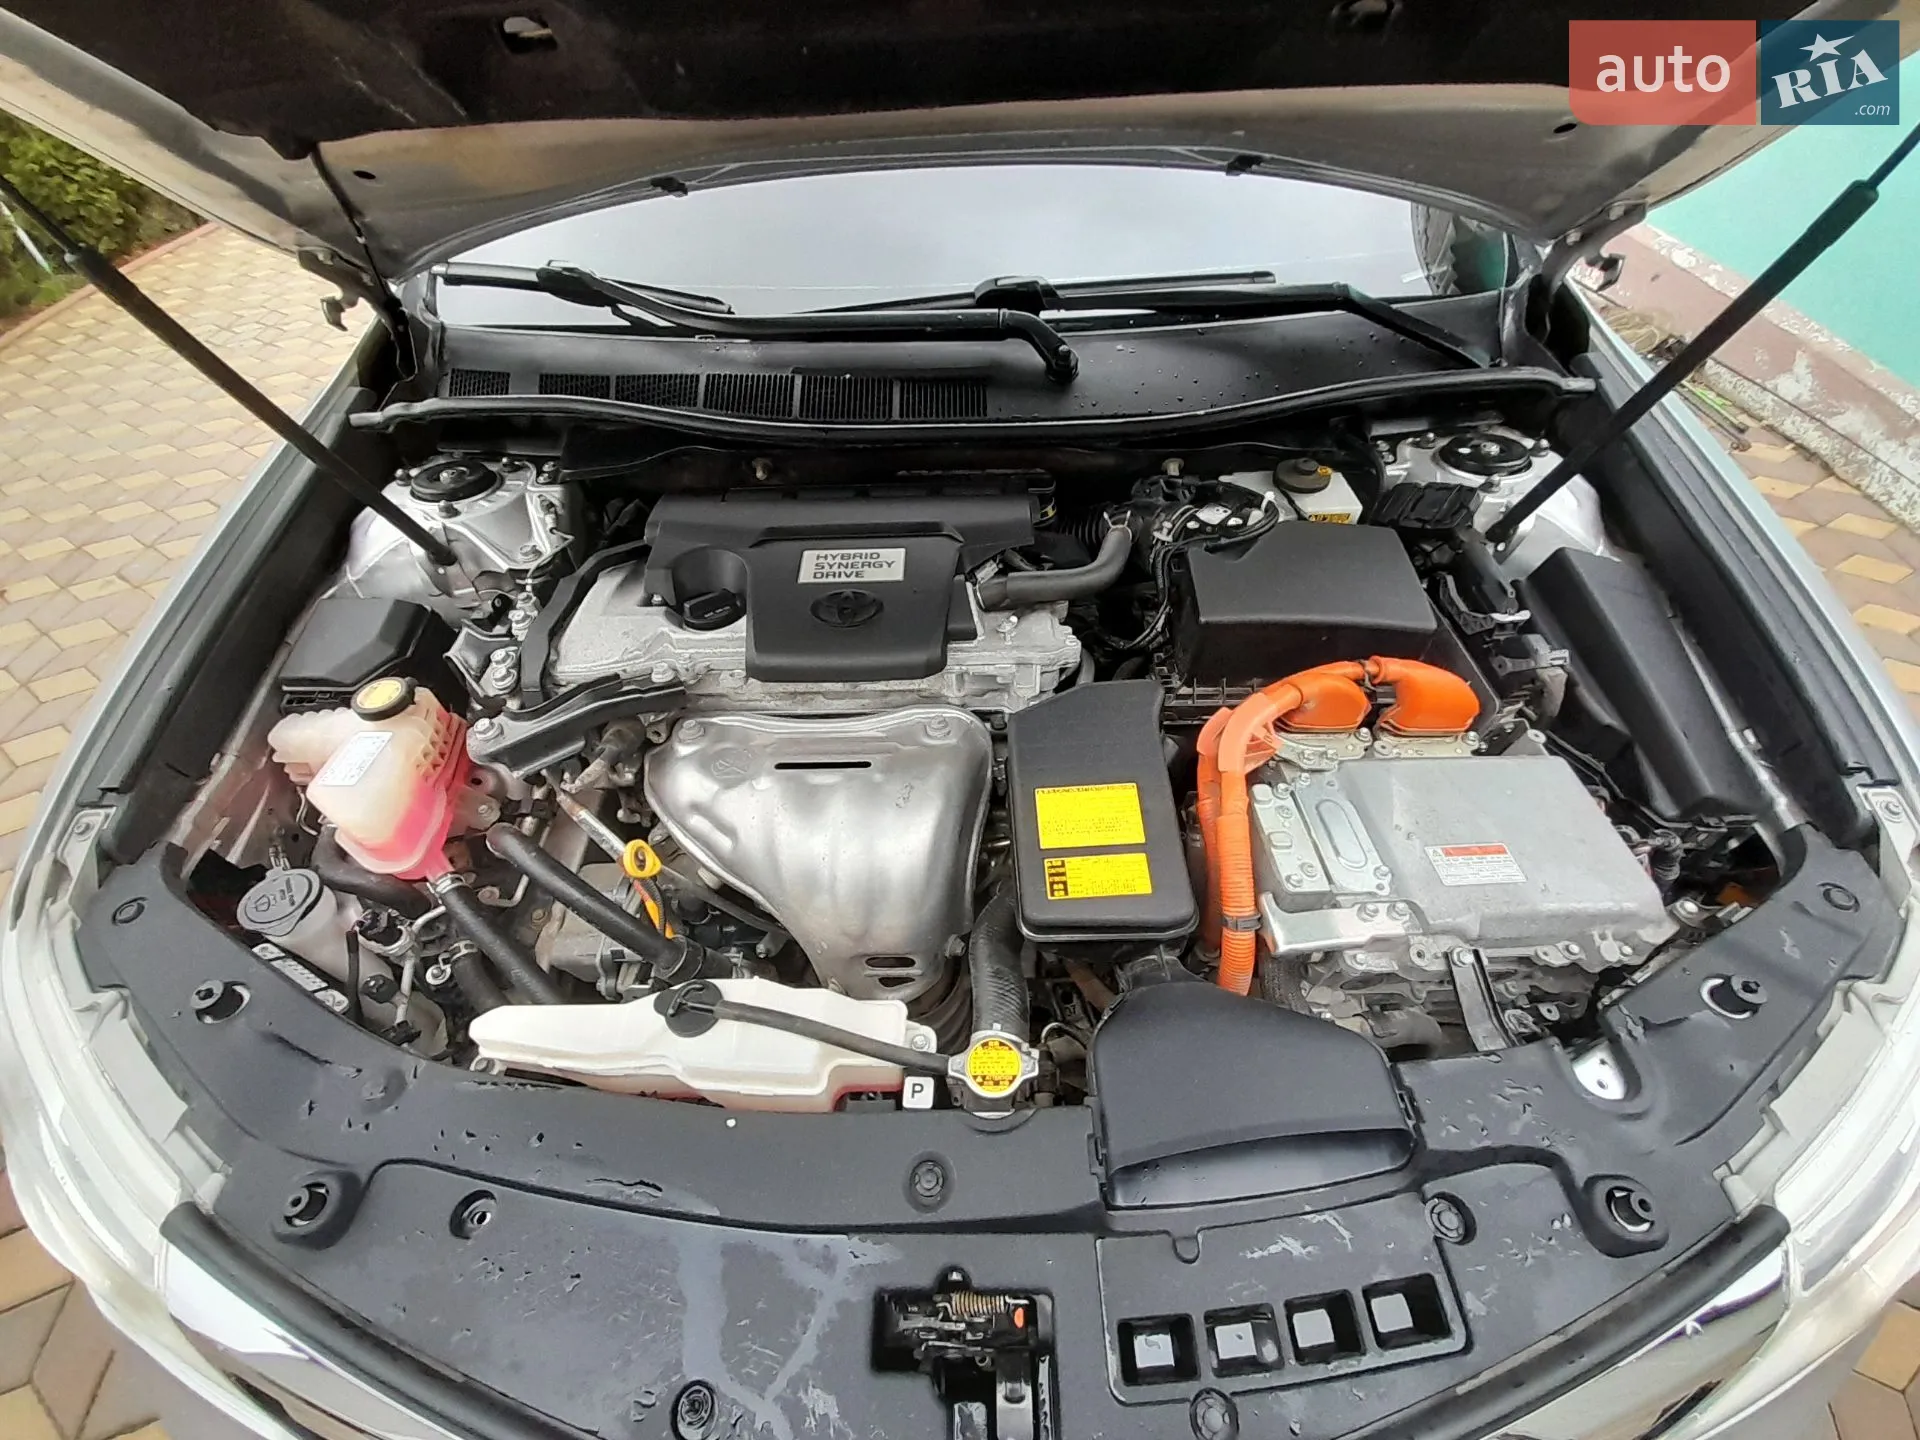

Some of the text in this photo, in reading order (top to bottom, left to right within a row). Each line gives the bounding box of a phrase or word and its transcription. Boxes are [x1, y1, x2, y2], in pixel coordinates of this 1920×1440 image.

[815, 552, 881, 561] HYBRID
[814, 560, 896, 570] SYNERGY
[813, 570, 865, 580] DRIVE
[911, 1083, 924, 1099] P
